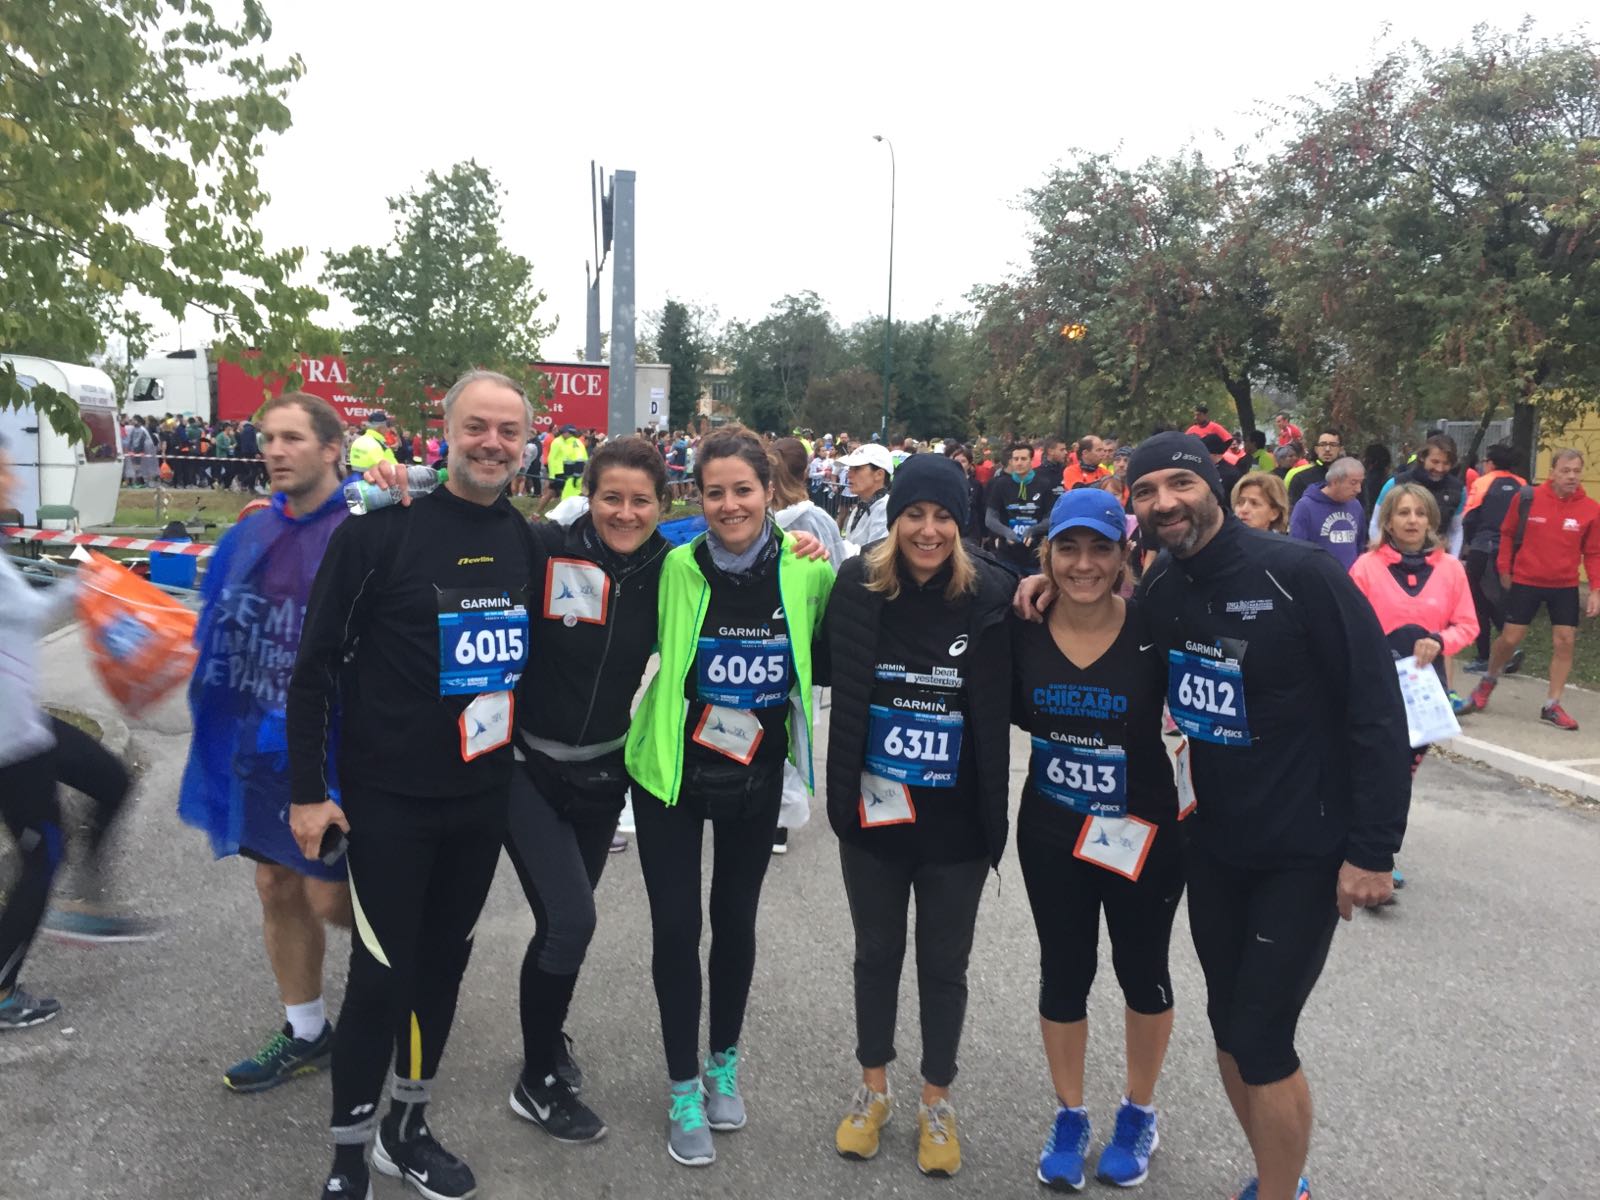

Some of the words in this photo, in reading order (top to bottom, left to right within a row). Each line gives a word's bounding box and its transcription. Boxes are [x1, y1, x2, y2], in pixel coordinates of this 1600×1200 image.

[651, 401, 658, 414] D
[460, 598, 512, 609] GARMIN
[719, 626, 771, 637] GARMIN
[455, 628, 524, 665] 6015
[1185, 640, 1223, 658] GARMIN
[707, 654, 784, 685] 6065
[875, 663, 906, 672] ARMIN
[934, 667, 957, 677] beat
[1033, 687, 1128, 713] CHICAGO
[1178, 672, 1237, 717] 6312
[893, 697, 946, 712] GARMIN
[884, 726, 949, 761] 6311
[1050, 731, 1103, 747] GARMIN
[1046, 757, 1117, 794] 6313
